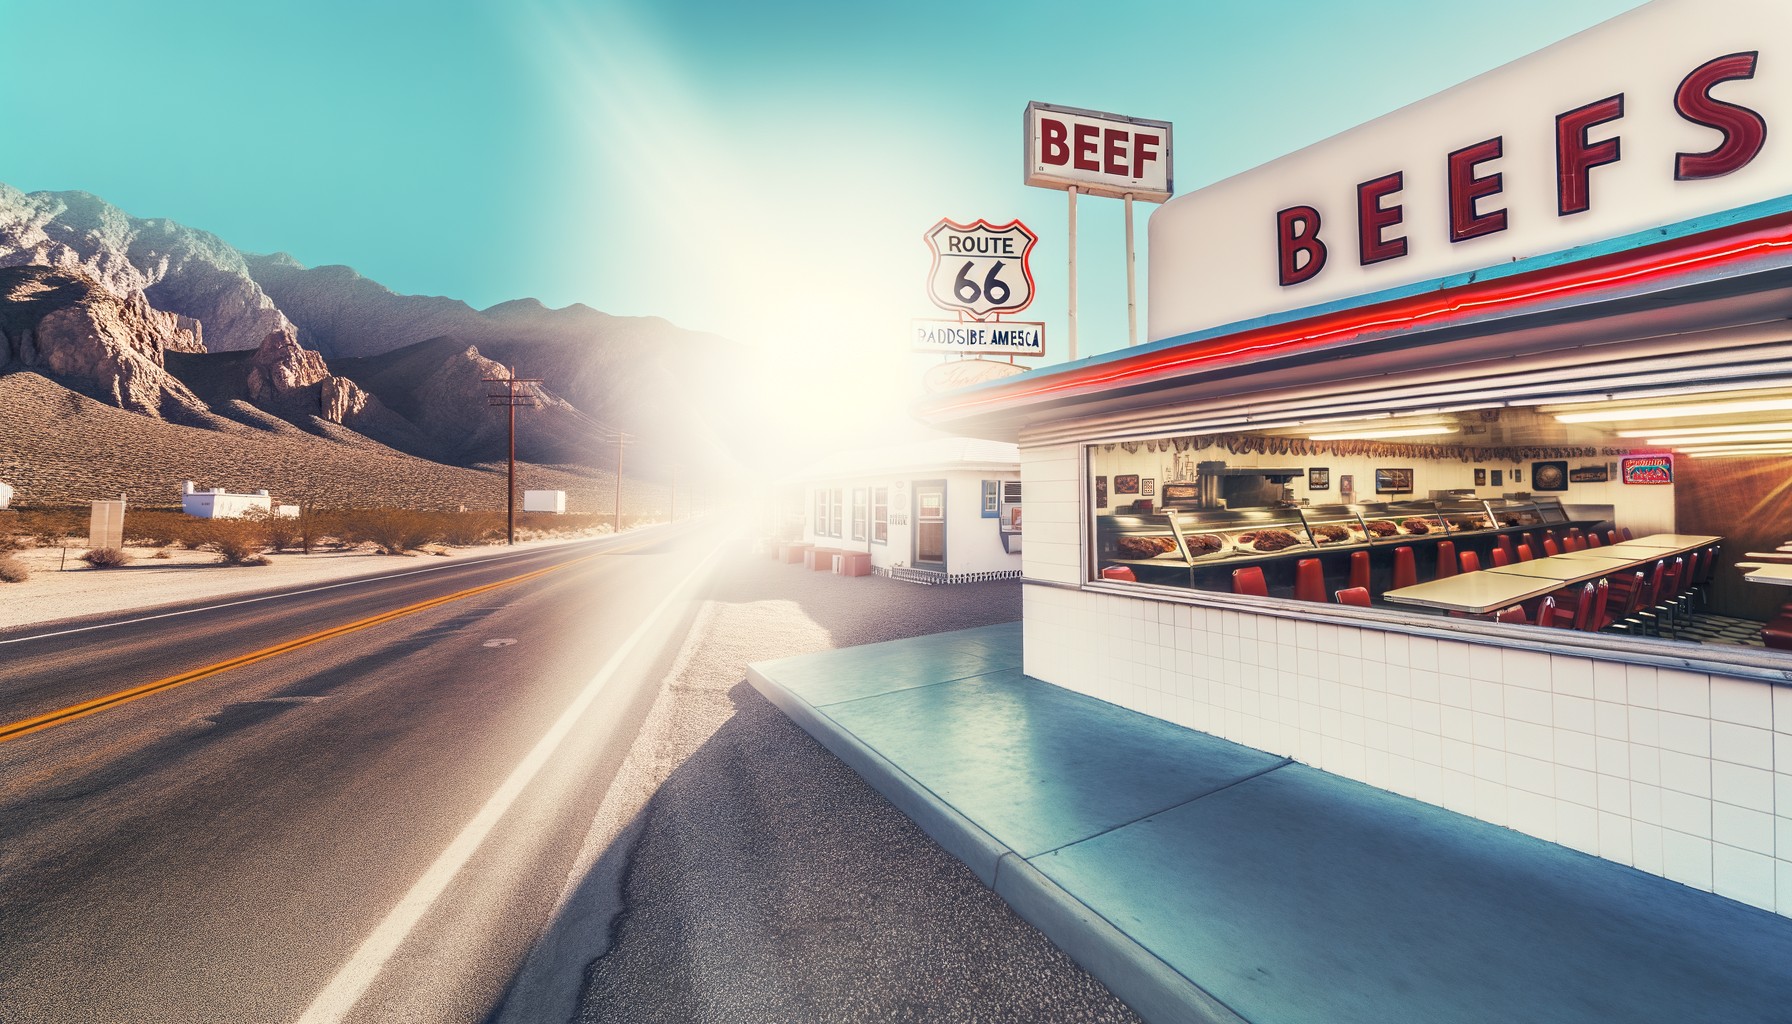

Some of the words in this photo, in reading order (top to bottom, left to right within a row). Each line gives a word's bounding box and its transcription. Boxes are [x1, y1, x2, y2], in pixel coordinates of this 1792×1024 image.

[1041, 117, 1160, 179] BEEF
[1276, 50, 1768, 287] BEEFS
[948, 235, 1014, 254] ROUTE
[953, 260, 1011, 305] 66
